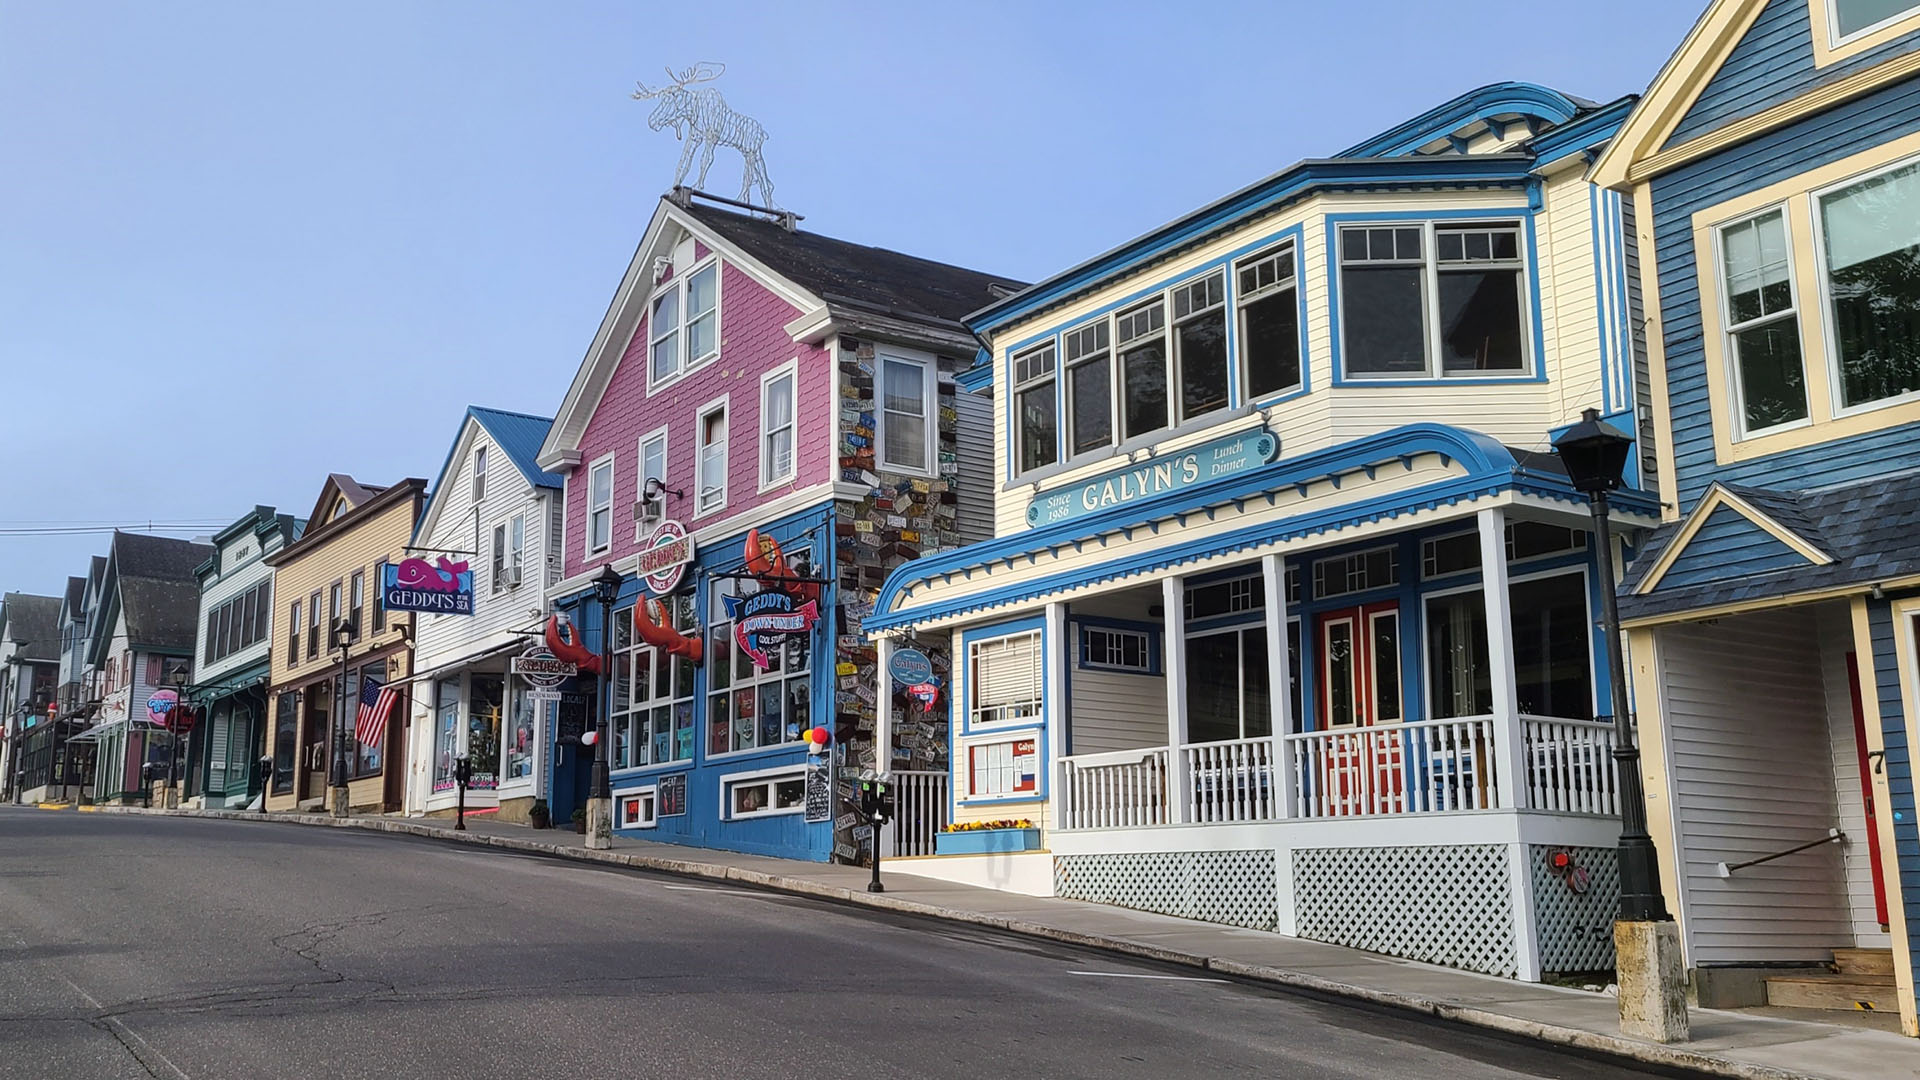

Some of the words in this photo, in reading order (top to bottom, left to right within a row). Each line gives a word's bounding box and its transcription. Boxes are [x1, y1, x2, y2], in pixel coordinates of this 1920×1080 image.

[1213, 439, 1243, 461] Lunch
[1211, 455, 1247, 476] Dinner
[1081, 452, 1200, 512] GALYN'S
[1047, 492, 1072, 509] Since
[1048, 506, 1069, 522] 1986
[389, 590, 455, 609] GEDDY'S
[456, 600, 469, 610] SEA
[744, 593, 791, 616] GEDDY'S
[758, 634, 771, 645] COOL
